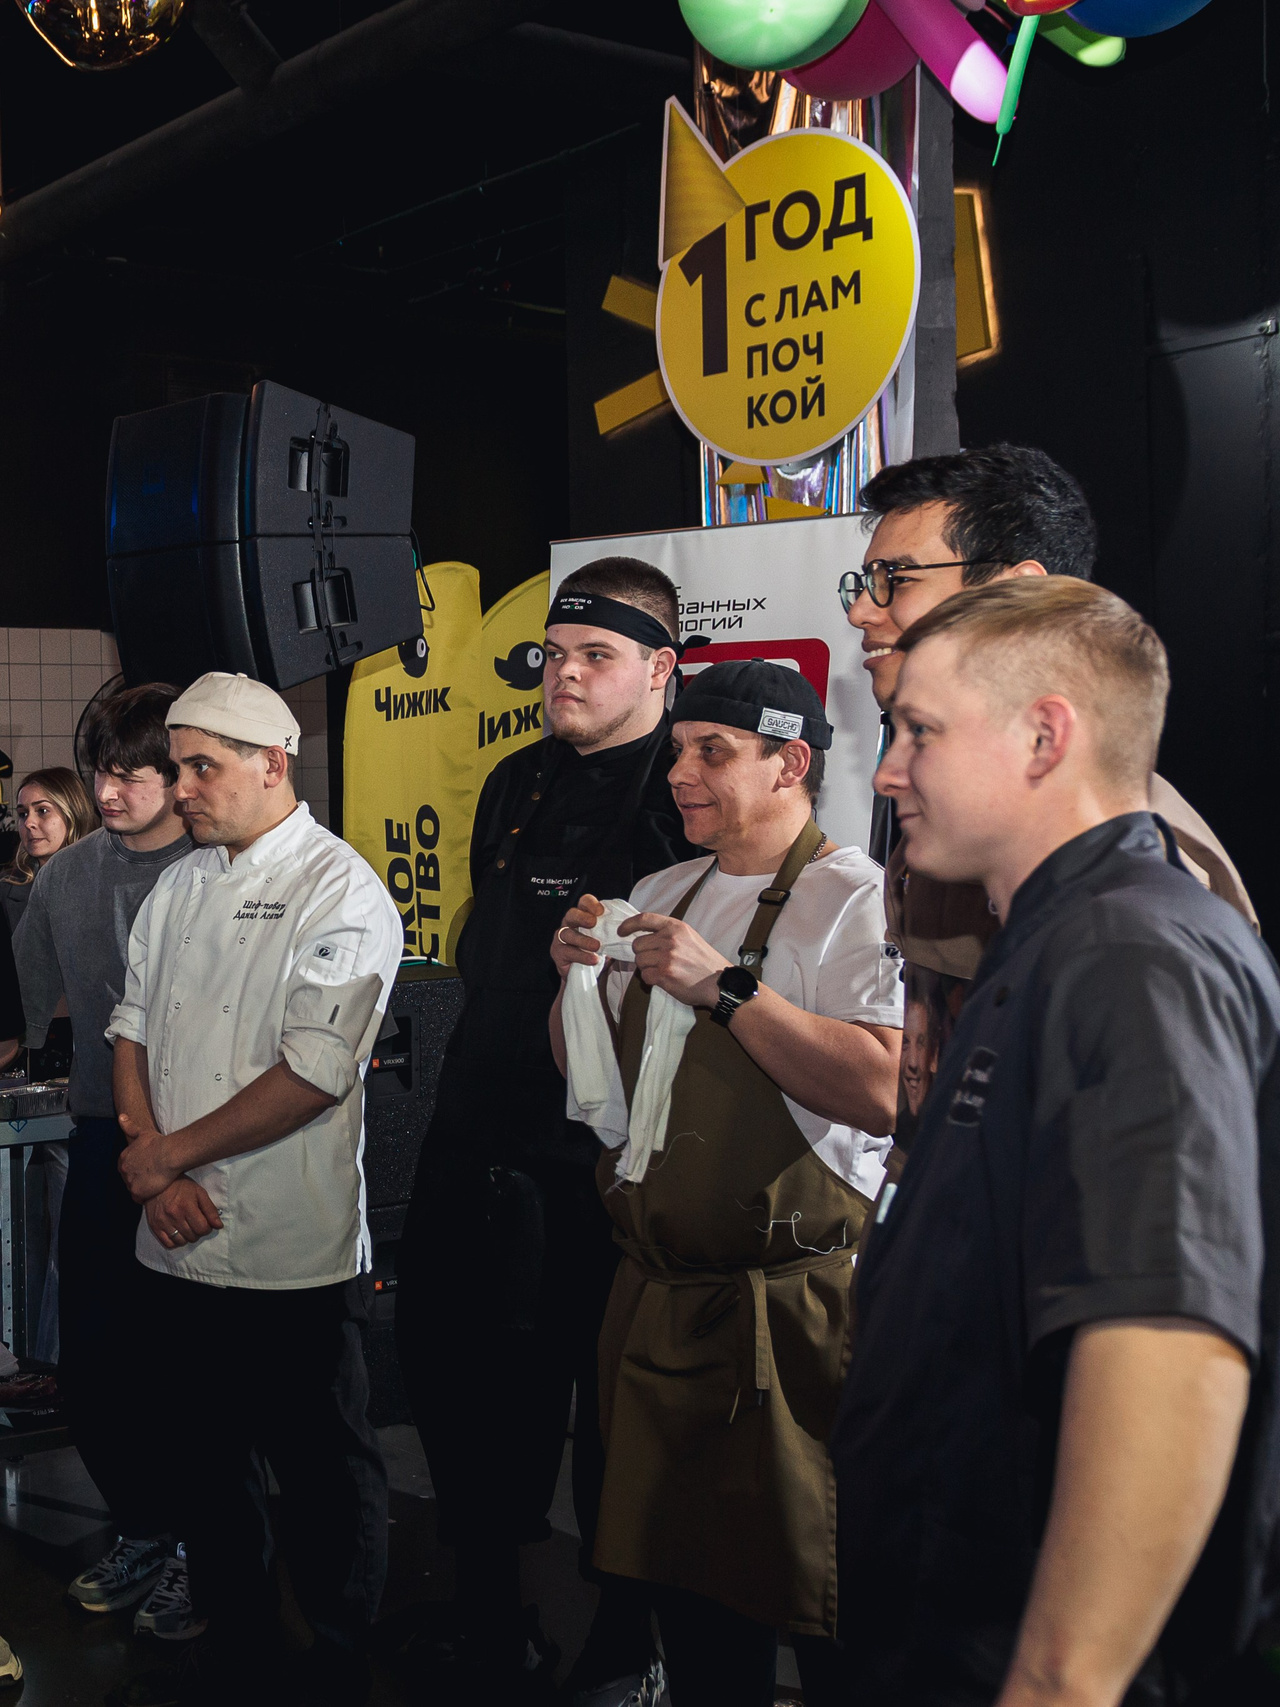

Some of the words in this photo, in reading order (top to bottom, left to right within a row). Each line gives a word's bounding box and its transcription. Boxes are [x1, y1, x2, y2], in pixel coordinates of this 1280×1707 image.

[678, 222, 728, 377] 1
[745, 172, 873, 262] ГОД
[744, 293, 767, 327] С
[775, 269, 861, 323] ЛАМ
[747, 331, 824, 379] ПОЧ
[747, 374, 826, 429] КОЙ
